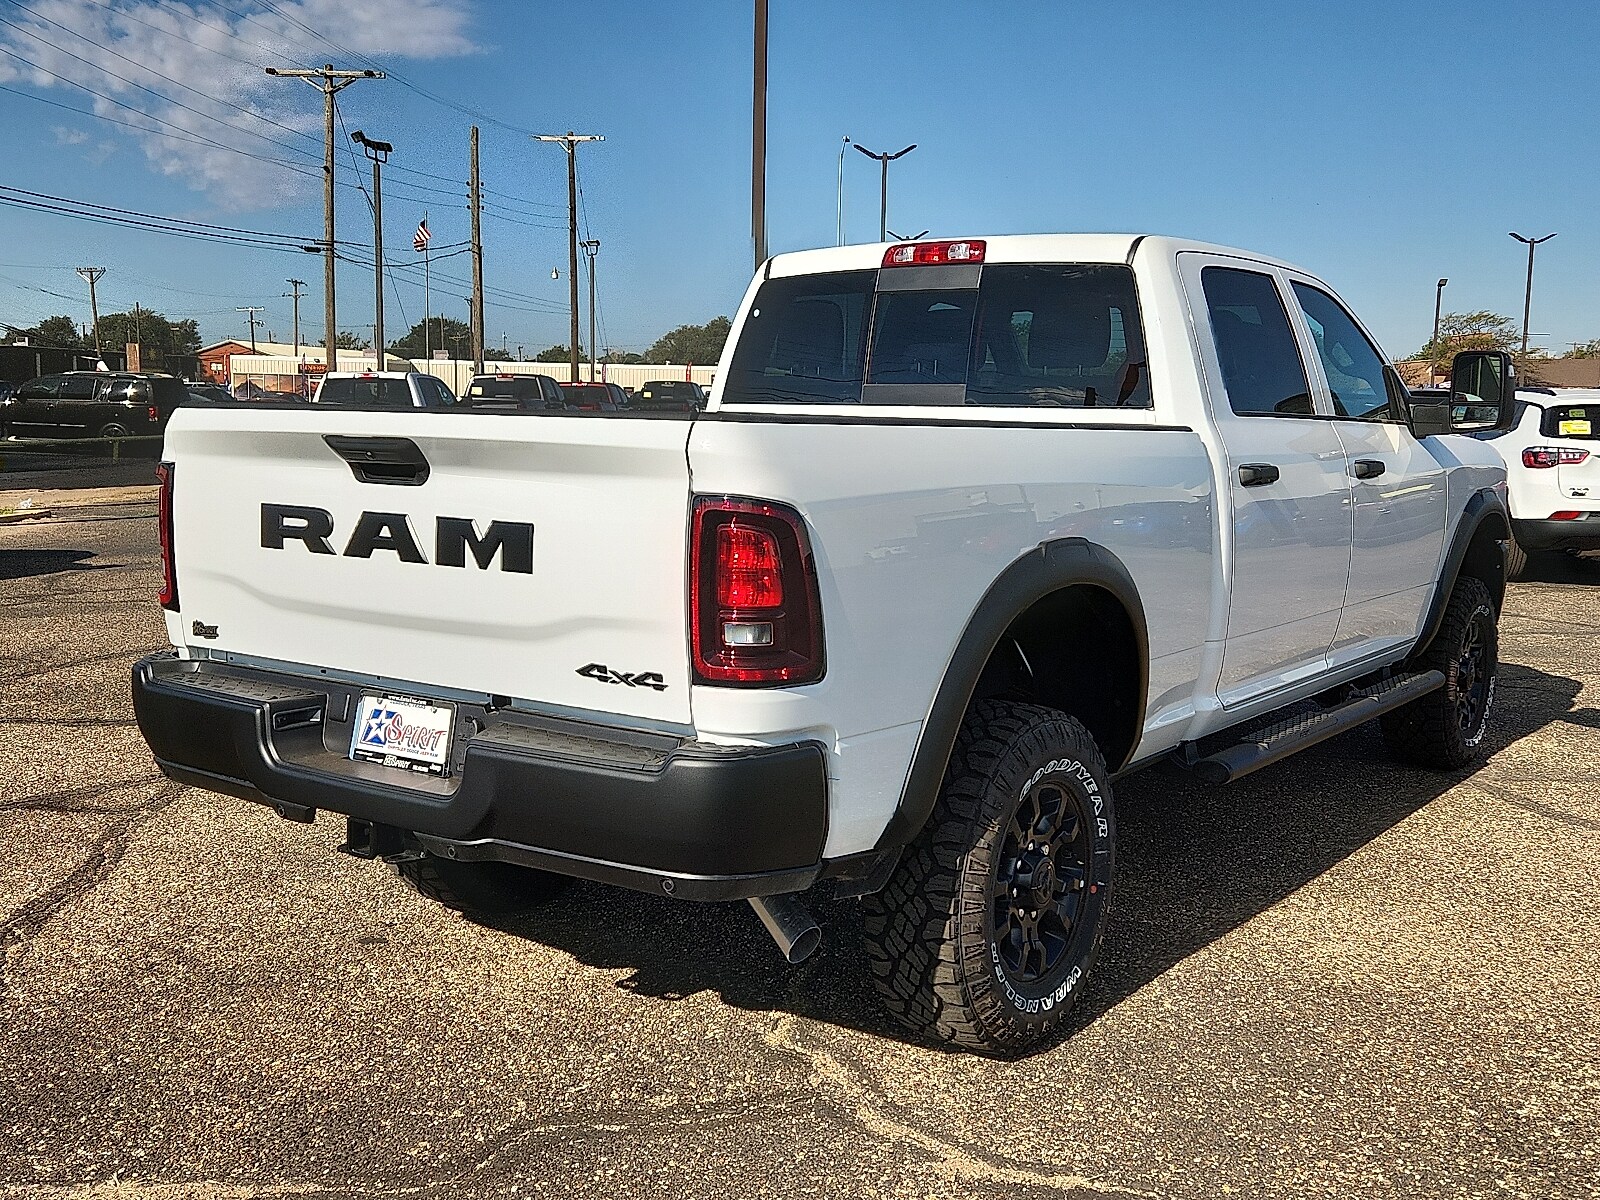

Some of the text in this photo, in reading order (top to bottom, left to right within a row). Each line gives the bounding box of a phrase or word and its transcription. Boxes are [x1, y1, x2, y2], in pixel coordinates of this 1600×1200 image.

[260, 502, 535, 574] RAM
[1018, 758, 1108, 838] GOODYEAR
[990, 942, 1082, 1013] WRANGLER
